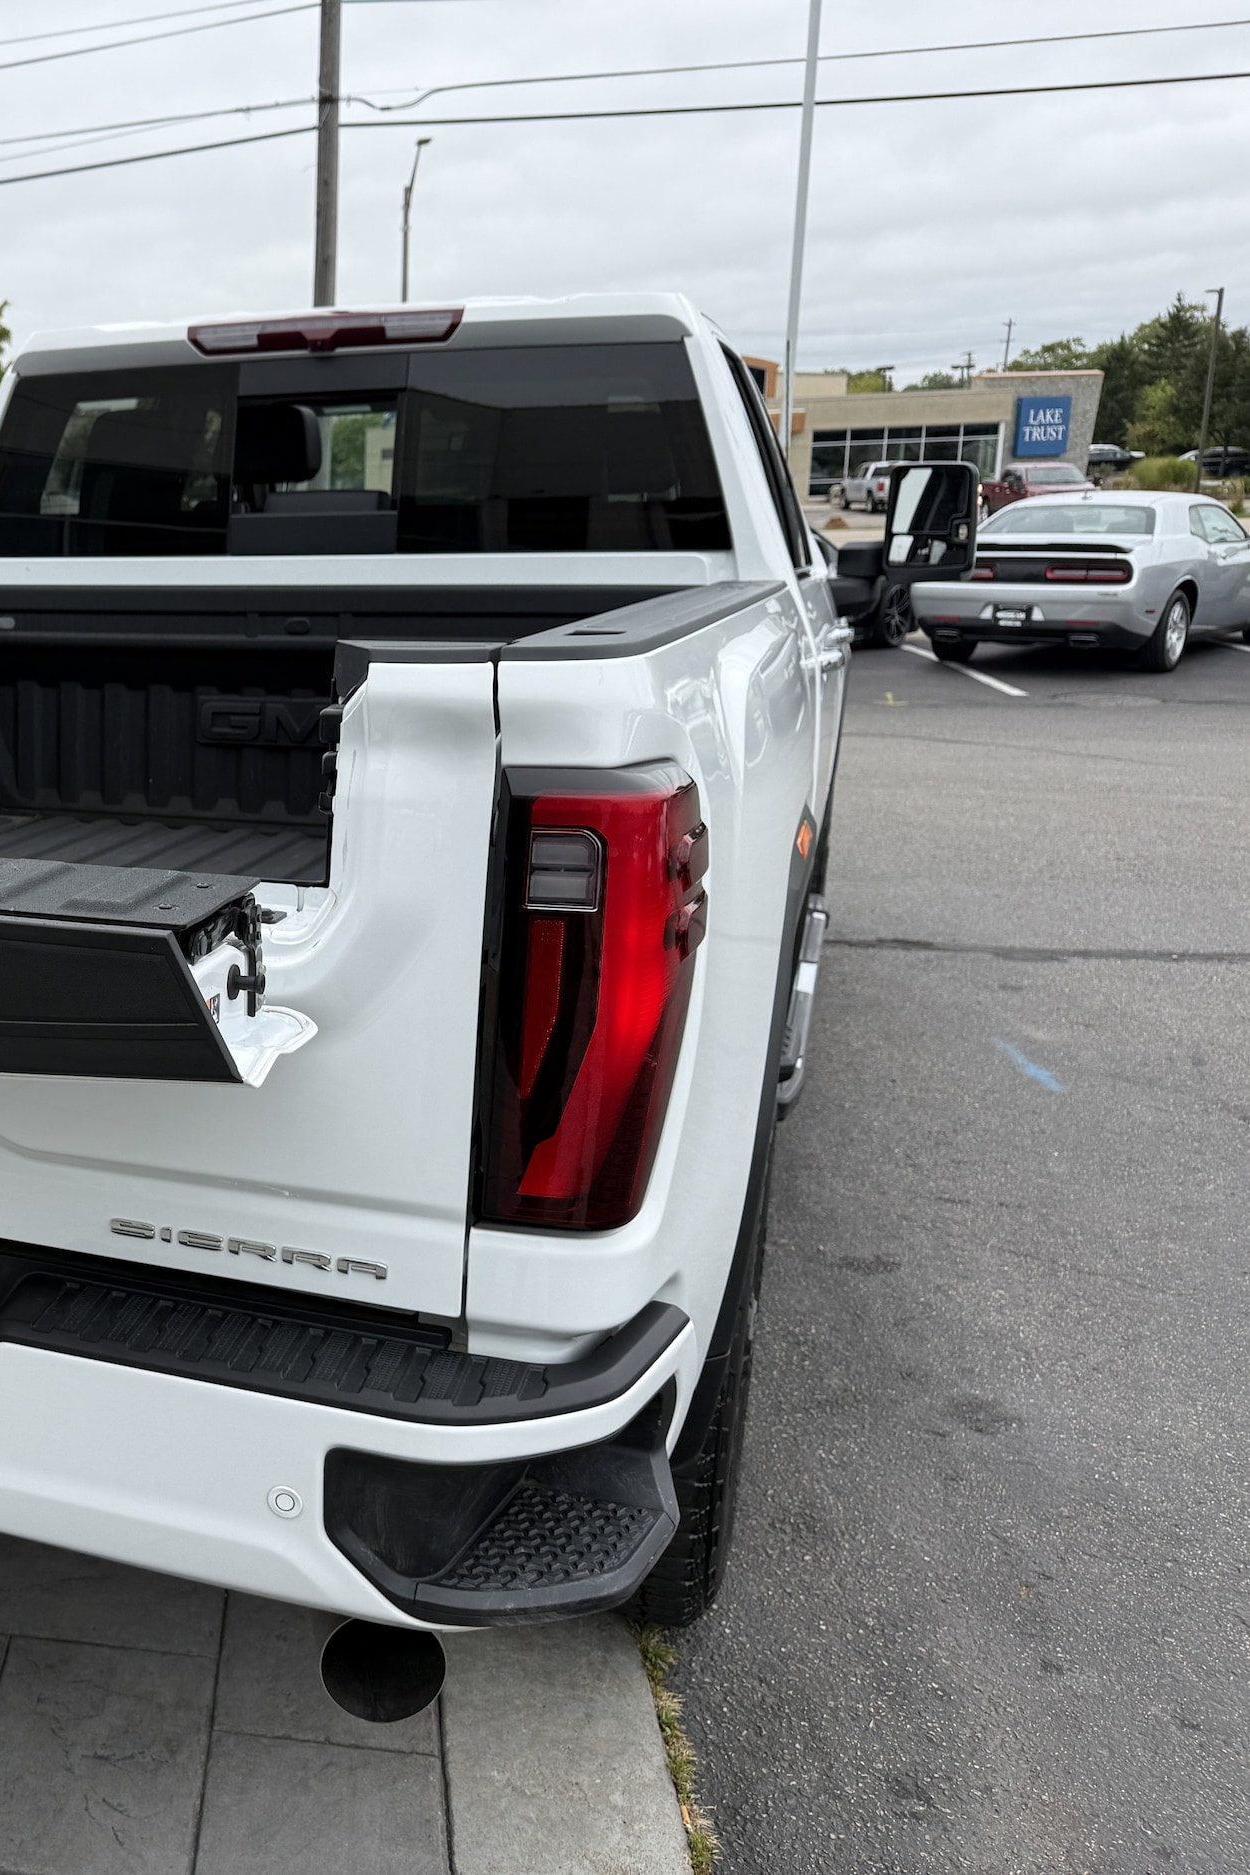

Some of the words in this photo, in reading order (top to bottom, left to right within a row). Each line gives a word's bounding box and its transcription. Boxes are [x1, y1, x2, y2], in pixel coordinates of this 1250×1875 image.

[1028, 408, 1064, 426] LAKE
[1022, 425, 1067, 443] TRUST
[201, 701, 323, 744] GM
[109, 1217, 388, 1280] SIERRA
